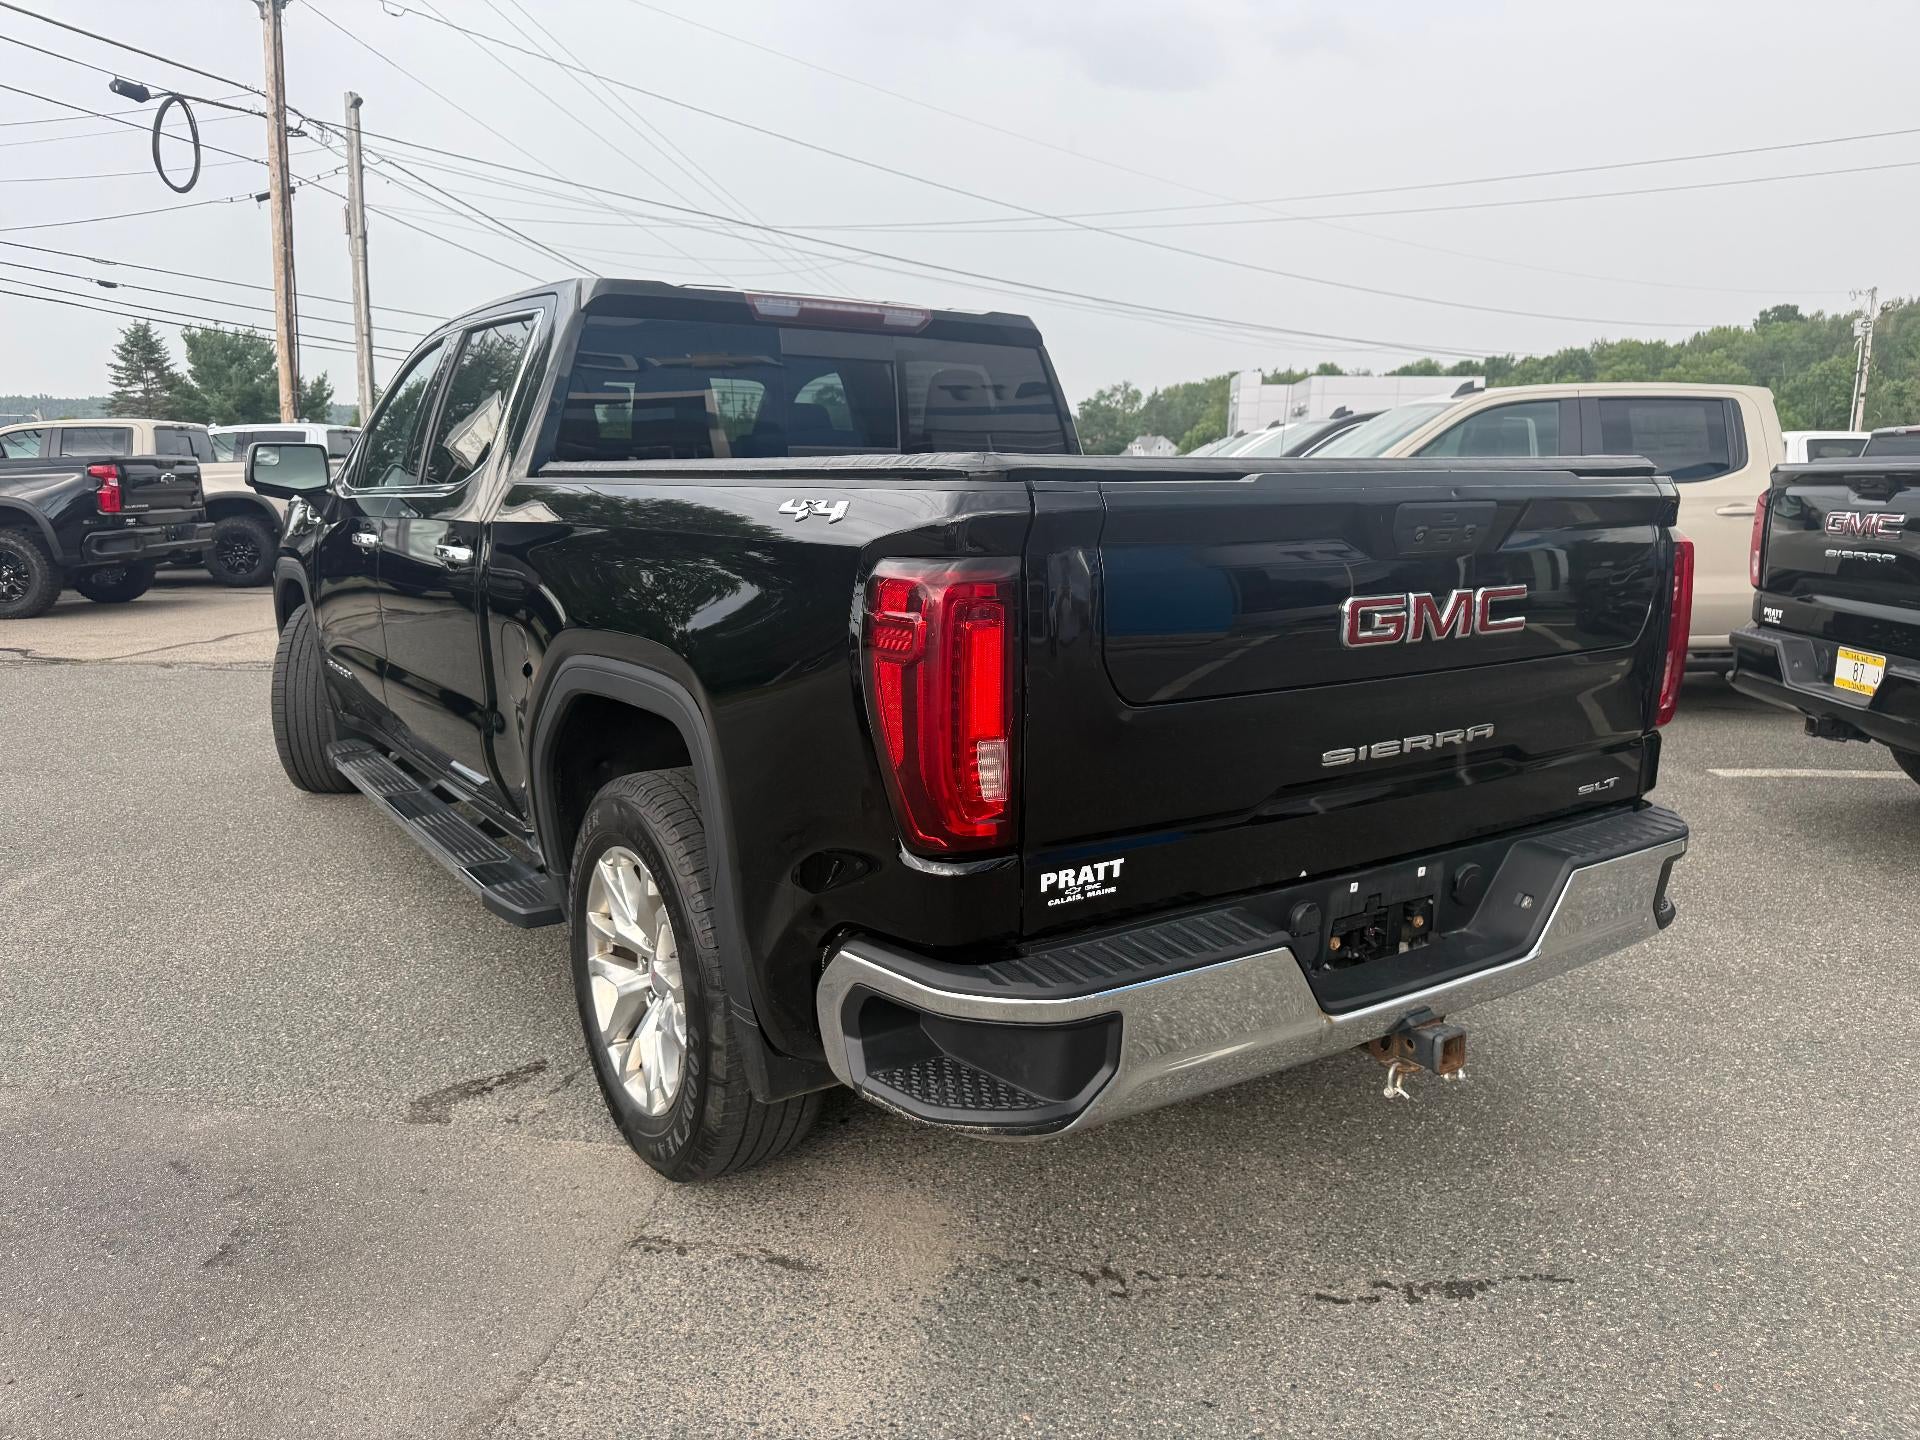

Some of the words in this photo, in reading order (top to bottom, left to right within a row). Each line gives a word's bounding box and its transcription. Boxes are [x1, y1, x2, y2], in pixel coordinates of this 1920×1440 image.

[1825, 511, 1905, 539] GMC
[1825, 548, 1897, 563] SIERRA
[1340, 583, 1528, 649] GMC
[1853, 662, 1865, 683] 87
[1321, 722, 1495, 767] SIERRA
[1577, 776, 1620, 796] SLT
[1040, 857, 1125, 893] PRATT
[1047, 893, 1084, 907] CALAIS,
[1086, 886, 1117, 898] MAINE
[1084, 882, 1102, 891] GMC
